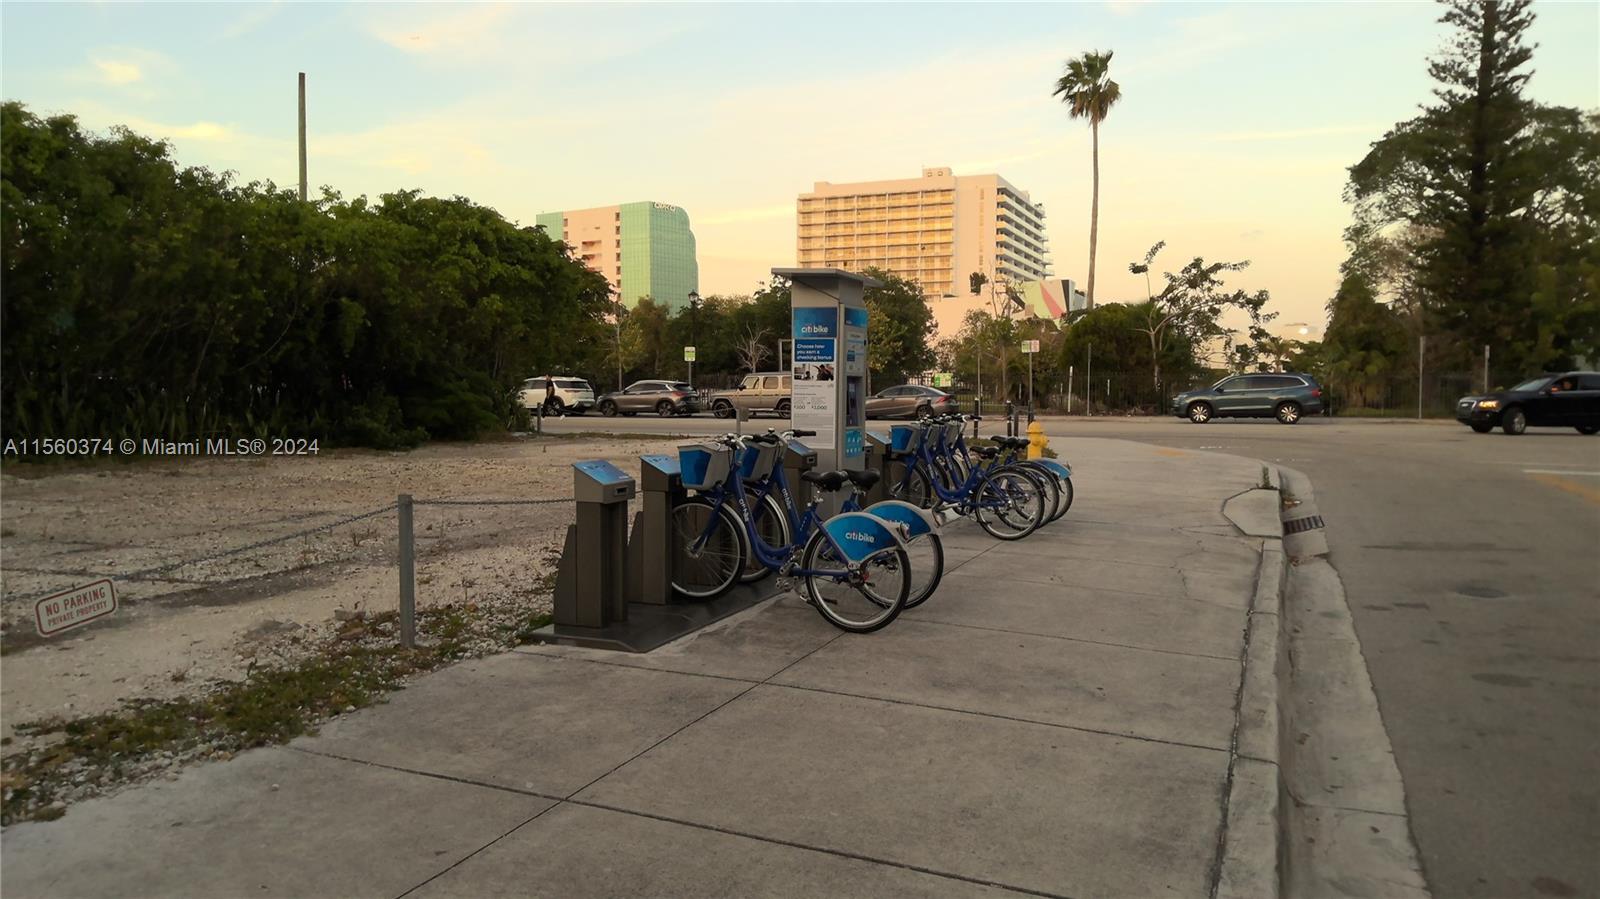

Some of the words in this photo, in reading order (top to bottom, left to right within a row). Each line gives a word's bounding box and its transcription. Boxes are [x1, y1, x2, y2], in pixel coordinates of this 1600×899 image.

[801, 325, 812, 333] citi
[813, 325, 828, 333] bike
[844, 531, 858, 541] citi
[858, 531, 875, 544] bike
[45, 603, 60, 617] NO
[63, 587, 106, 611] PARKING
[47, 613, 75, 627] PRIVATE
[76, 601, 107, 616] PROPERTY
